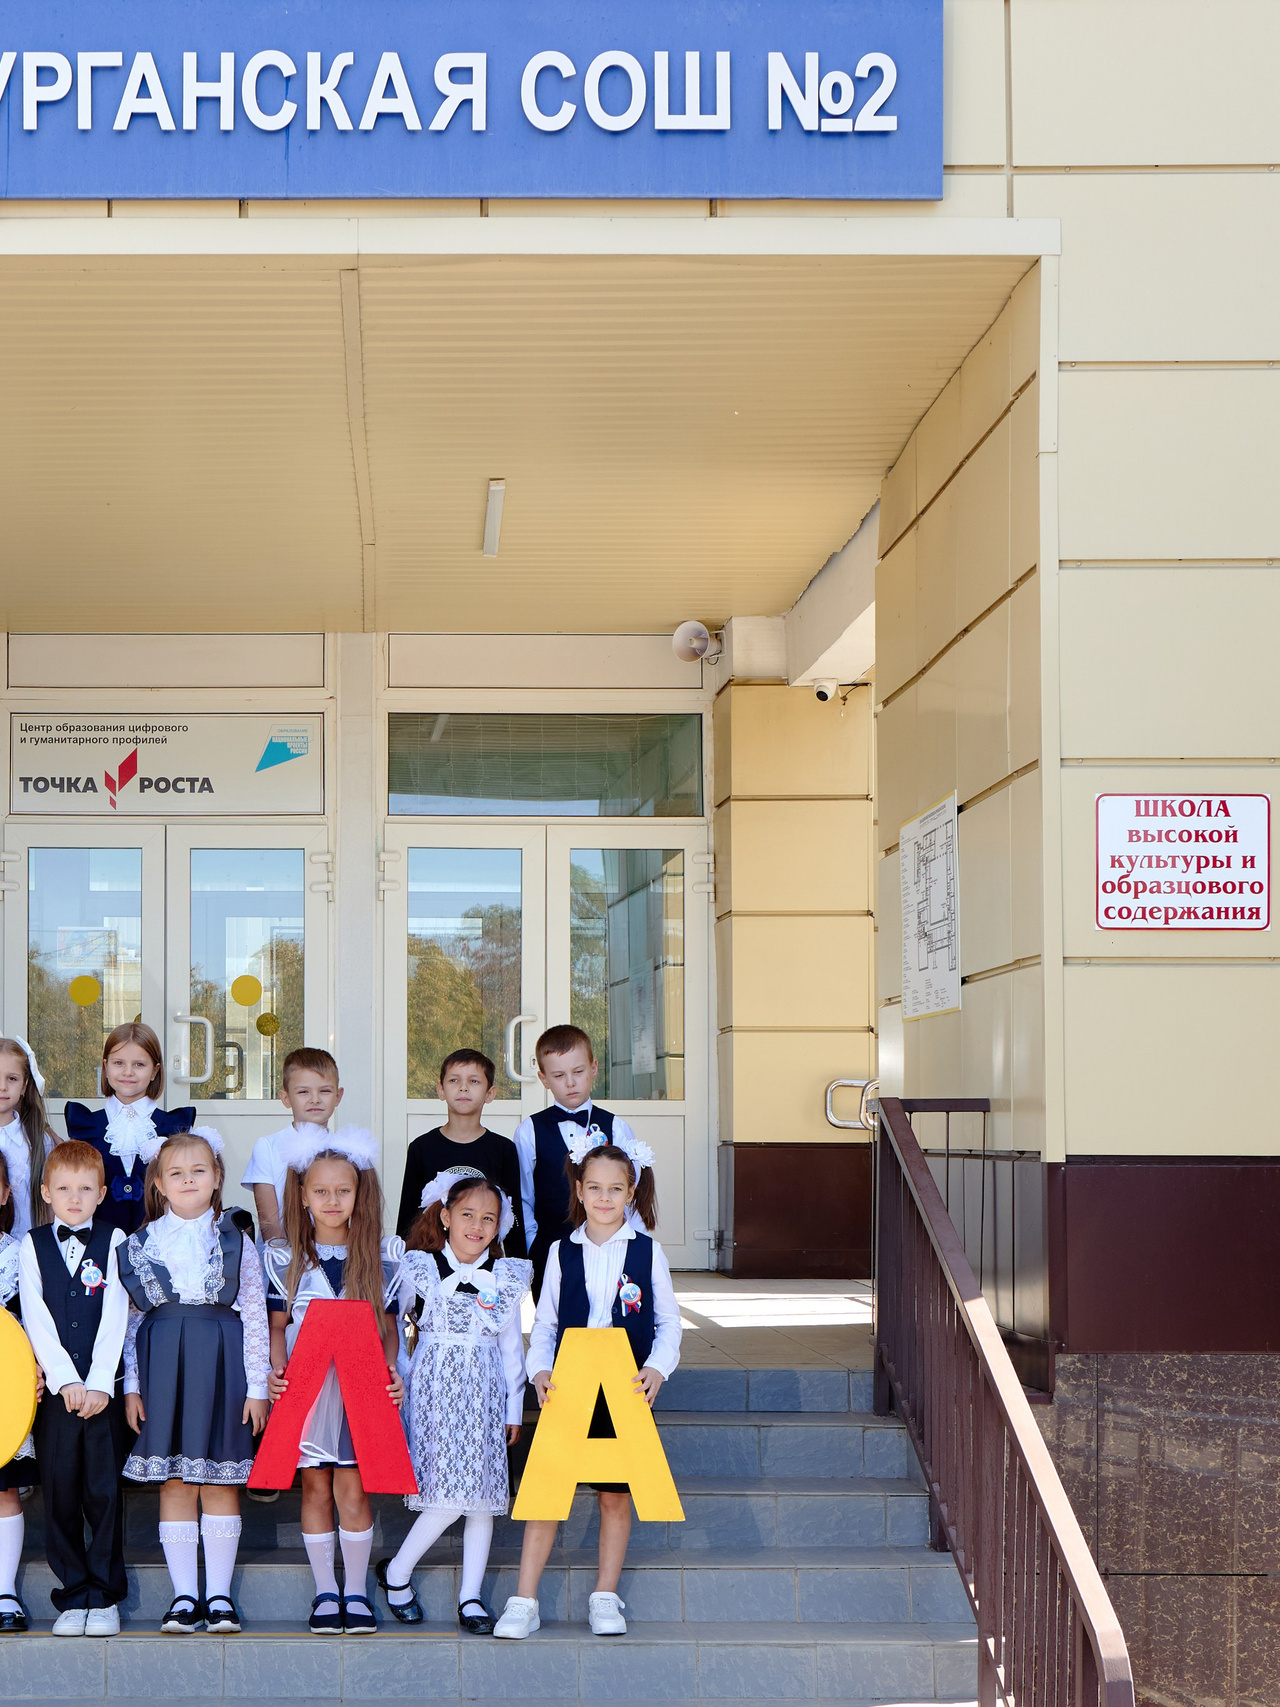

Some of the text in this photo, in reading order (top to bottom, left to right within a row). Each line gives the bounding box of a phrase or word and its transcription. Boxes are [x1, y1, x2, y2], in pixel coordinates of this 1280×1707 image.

[520, 50, 731, 131] СОШ
[767, 51, 898, 132] №2
[20, 722, 189, 734] Центр образования цифрового
[29, 737, 109, 746] гуманитарного
[112, 735, 168, 746] профилей
[19, 776, 215, 794] ТОЧКА РОСТА
[1134, 799, 1232, 818] ШКОЛА
[1127, 825, 1239, 843] высокой
[1109, 855, 1256, 875] культуры и
[1101, 873, 1264, 900] образцового
[1103, 906, 1262, 926] содержания
